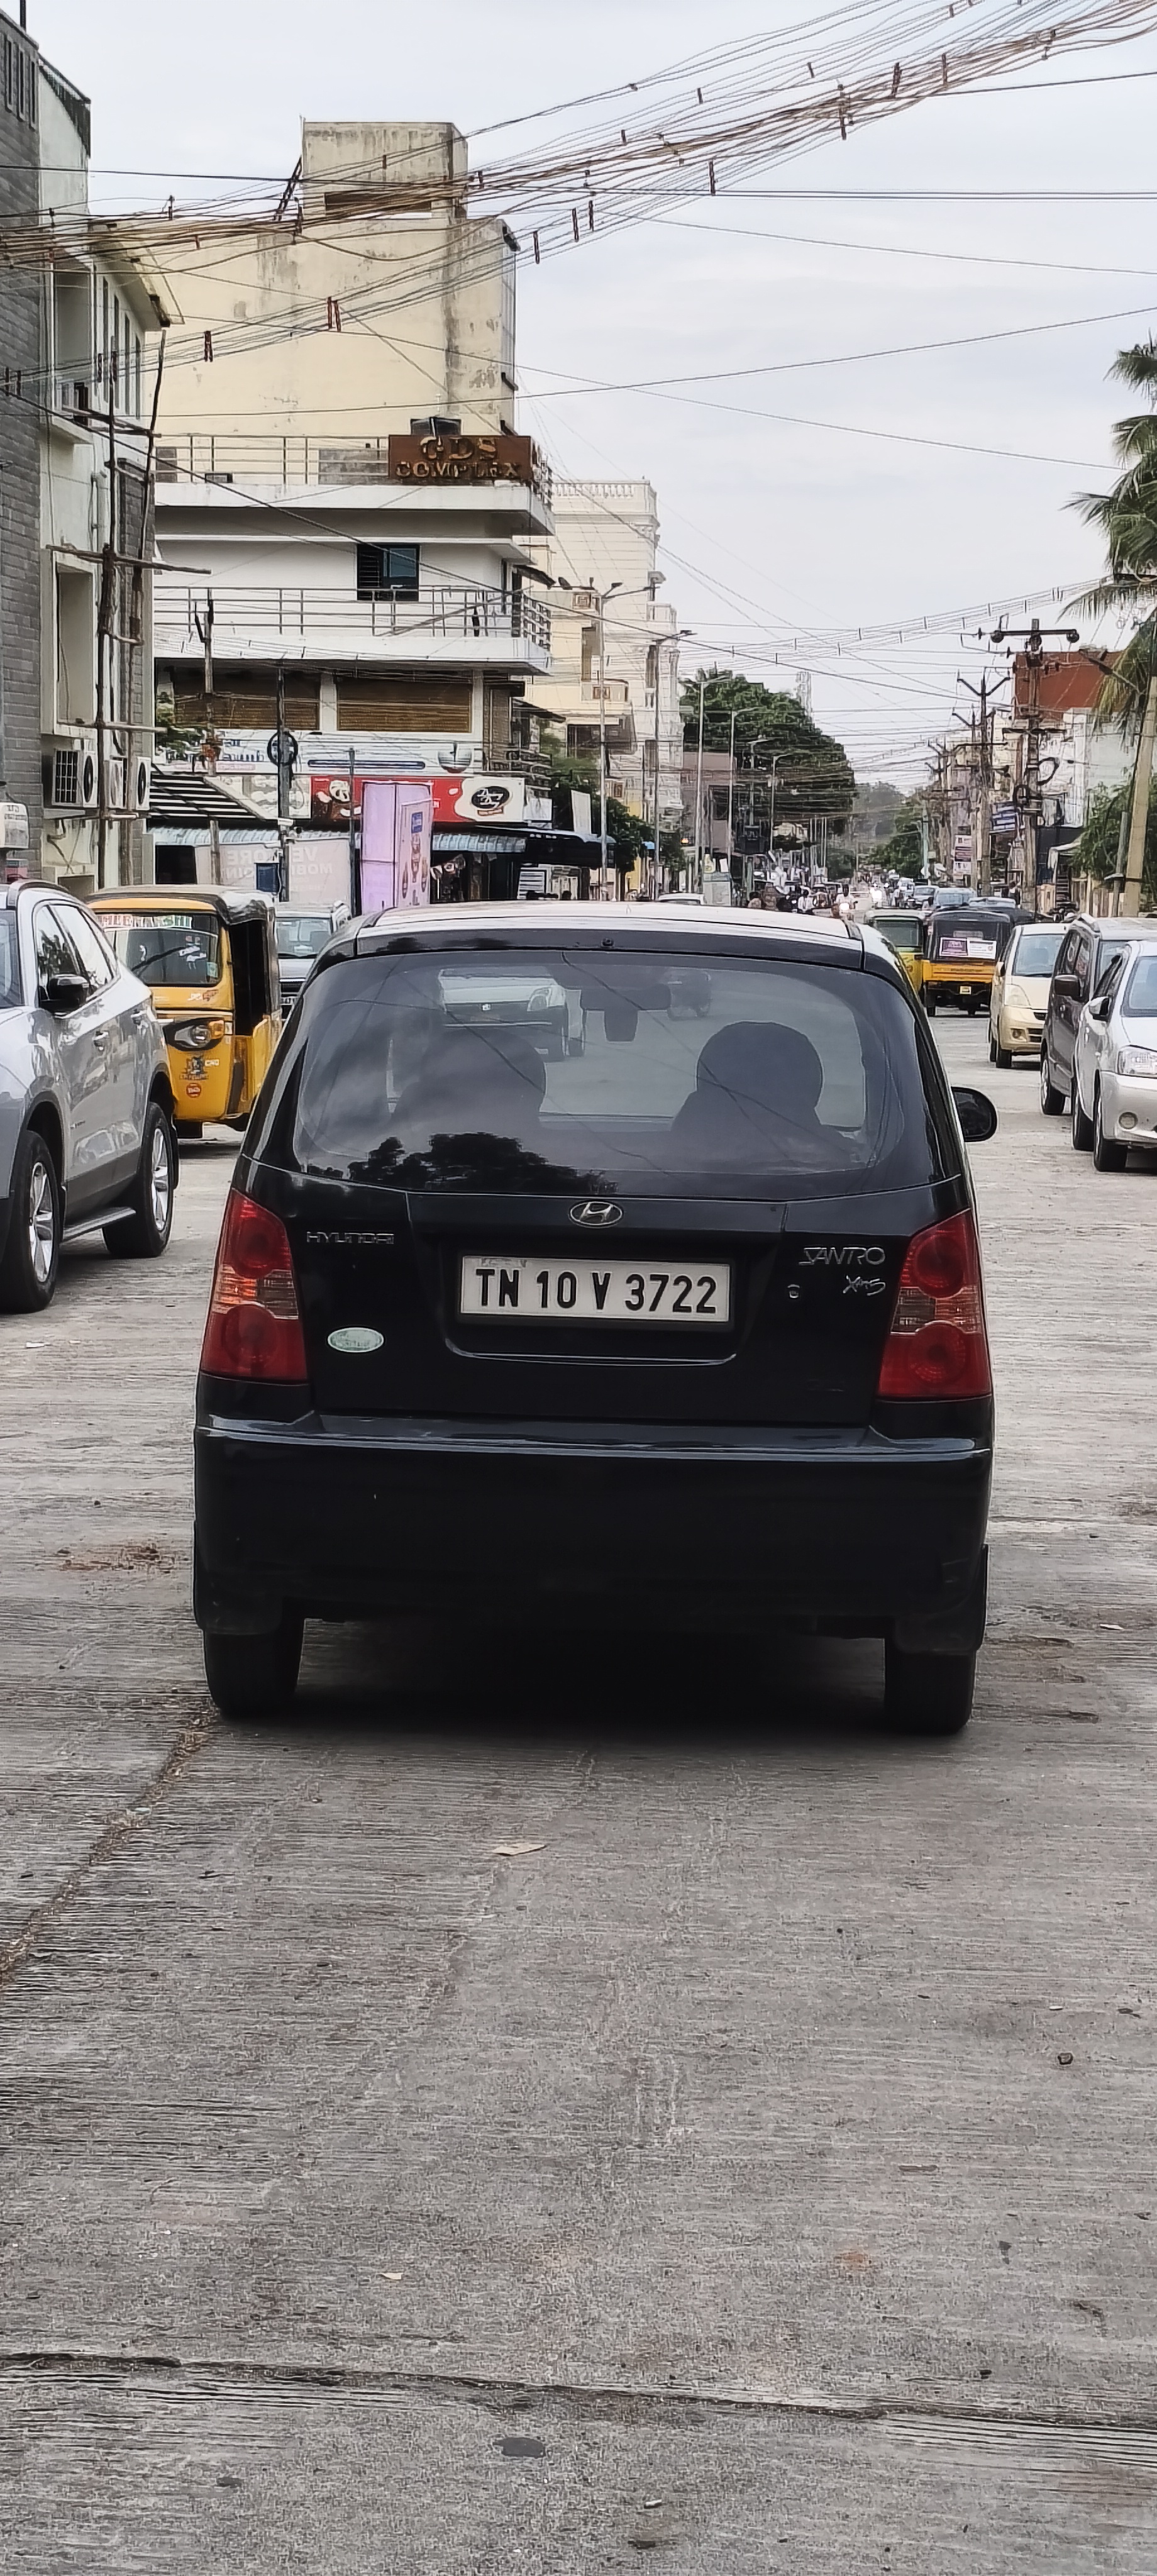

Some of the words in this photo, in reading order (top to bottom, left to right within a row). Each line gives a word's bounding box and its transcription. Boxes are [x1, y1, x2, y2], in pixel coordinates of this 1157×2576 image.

[306, 1231, 395, 1245] HYUNDAI
[798, 1246, 886, 1265] SANTRO
[475, 1269, 519, 1307] TN
[536, 1270, 577, 1309] 10
[591, 1272, 611, 1311] V
[624, 1274, 717, 1314] 3722
